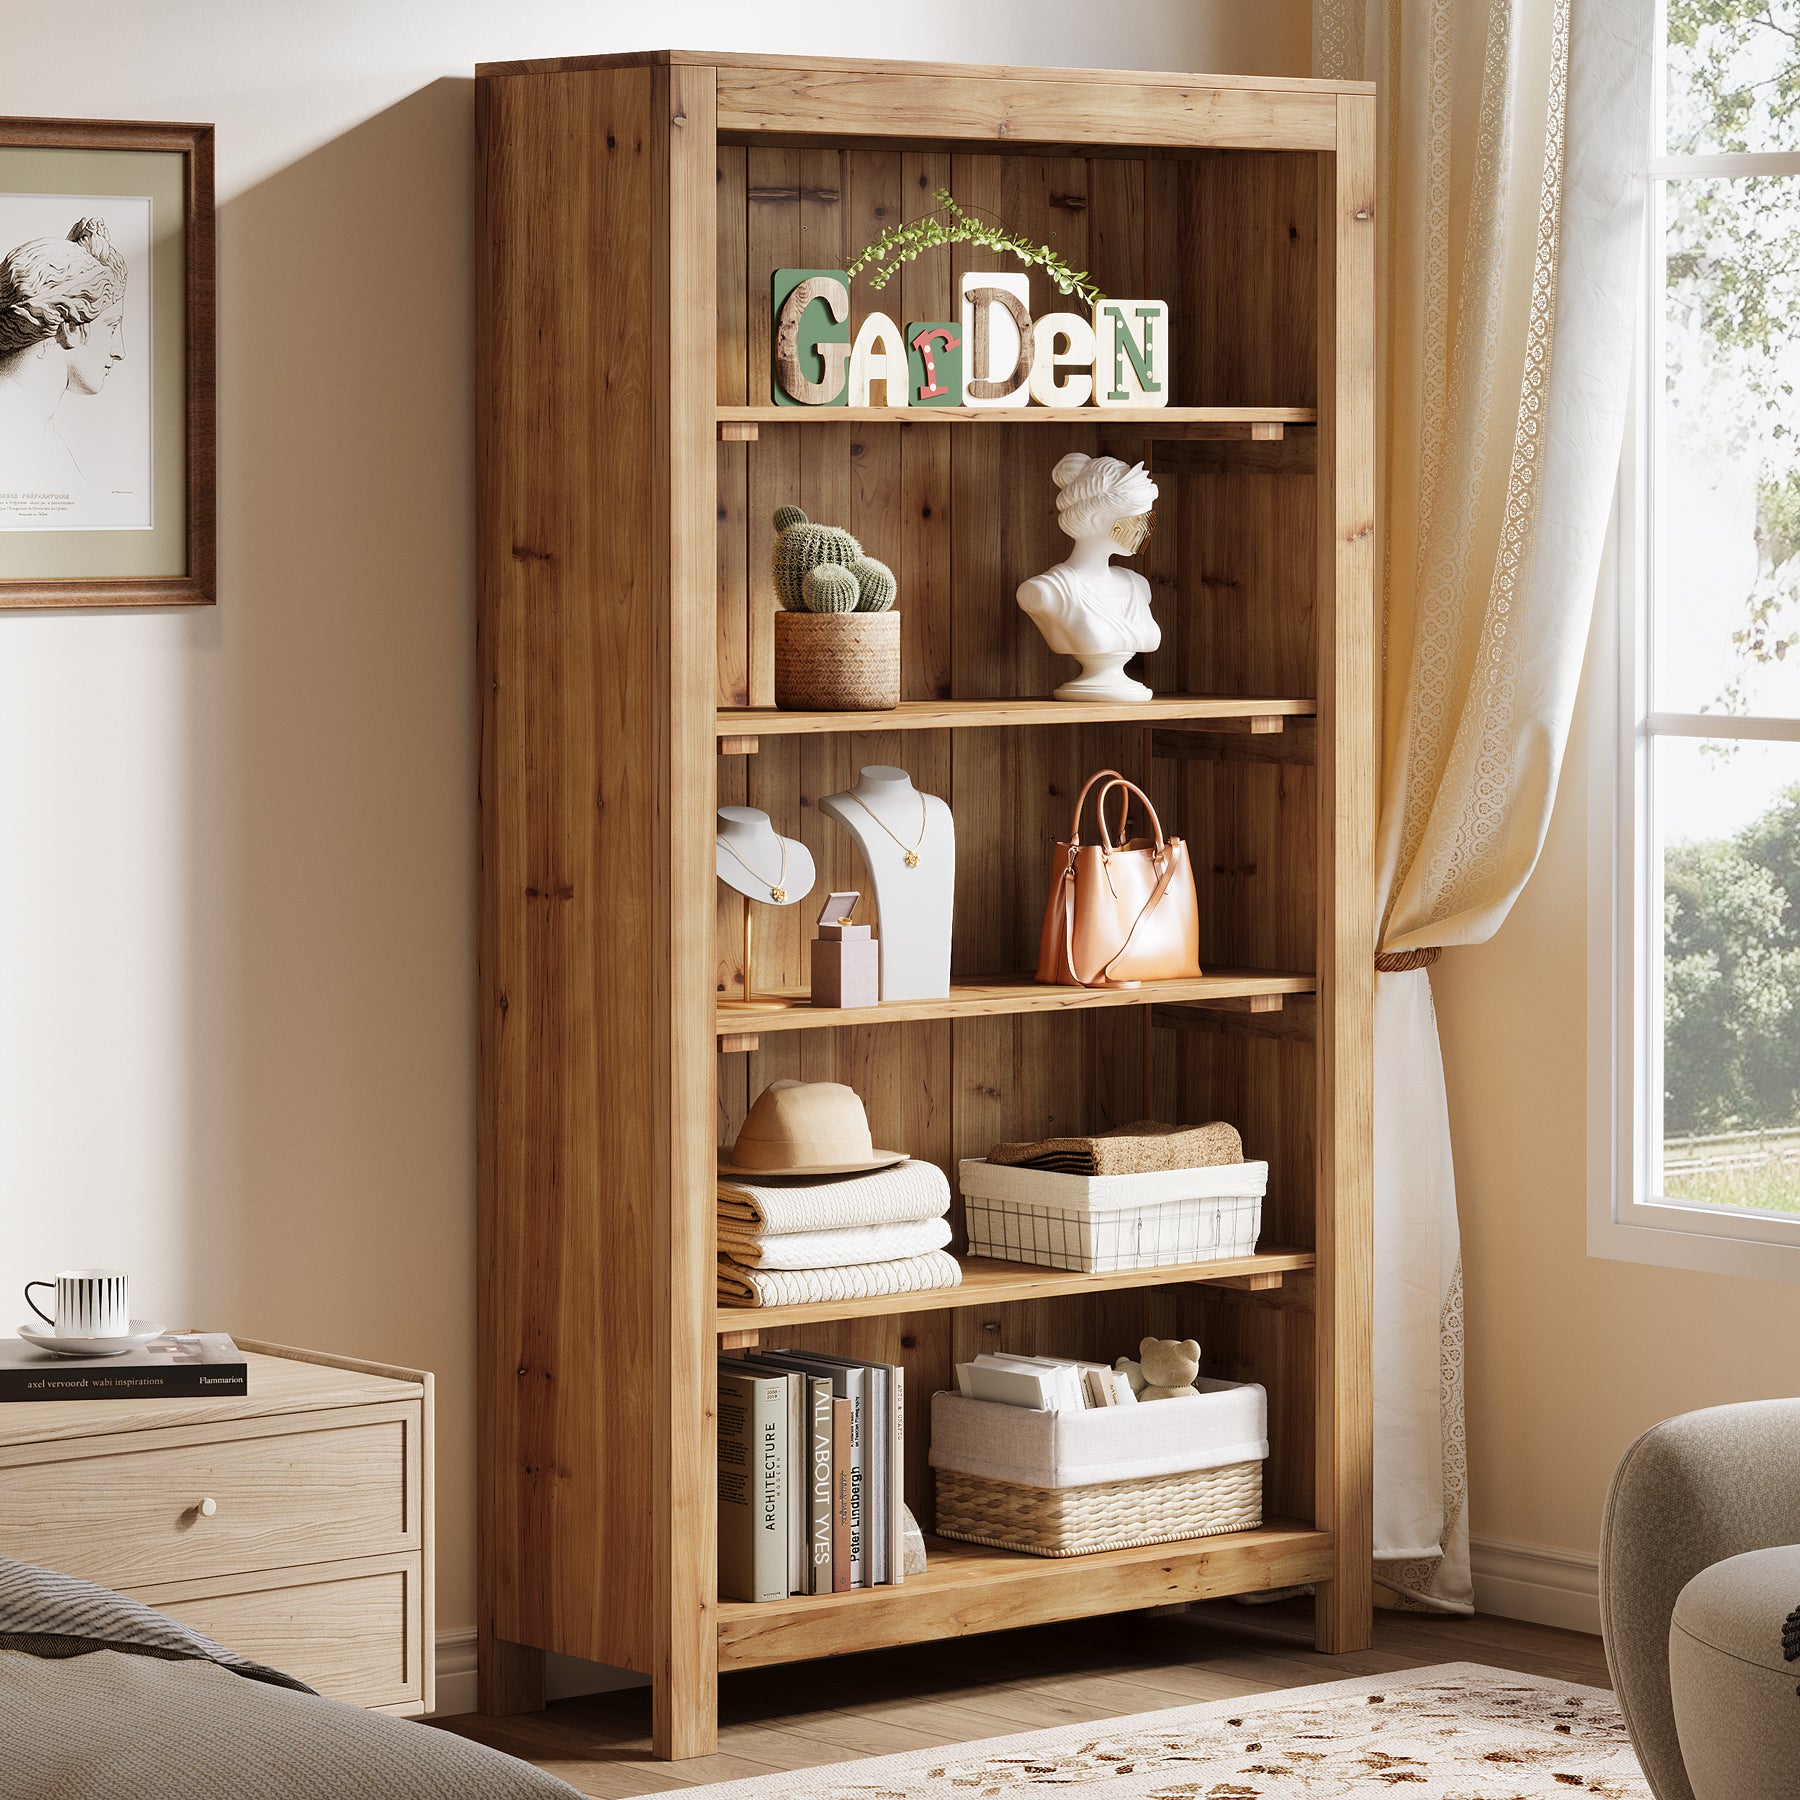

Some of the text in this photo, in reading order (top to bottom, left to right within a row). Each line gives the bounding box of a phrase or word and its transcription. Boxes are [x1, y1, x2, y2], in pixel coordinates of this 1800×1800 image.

[27, 1376, 164, 1389] axel vervoordt wabi inspirations
[199, 1375, 243, 1385] Flammarion
[765, 1422, 776, 1531] ARCHITECTURE
[814, 1389, 830, 1565] ALL ABOUT YVES
[850, 1466, 862, 1562] Peter Lindbergh
